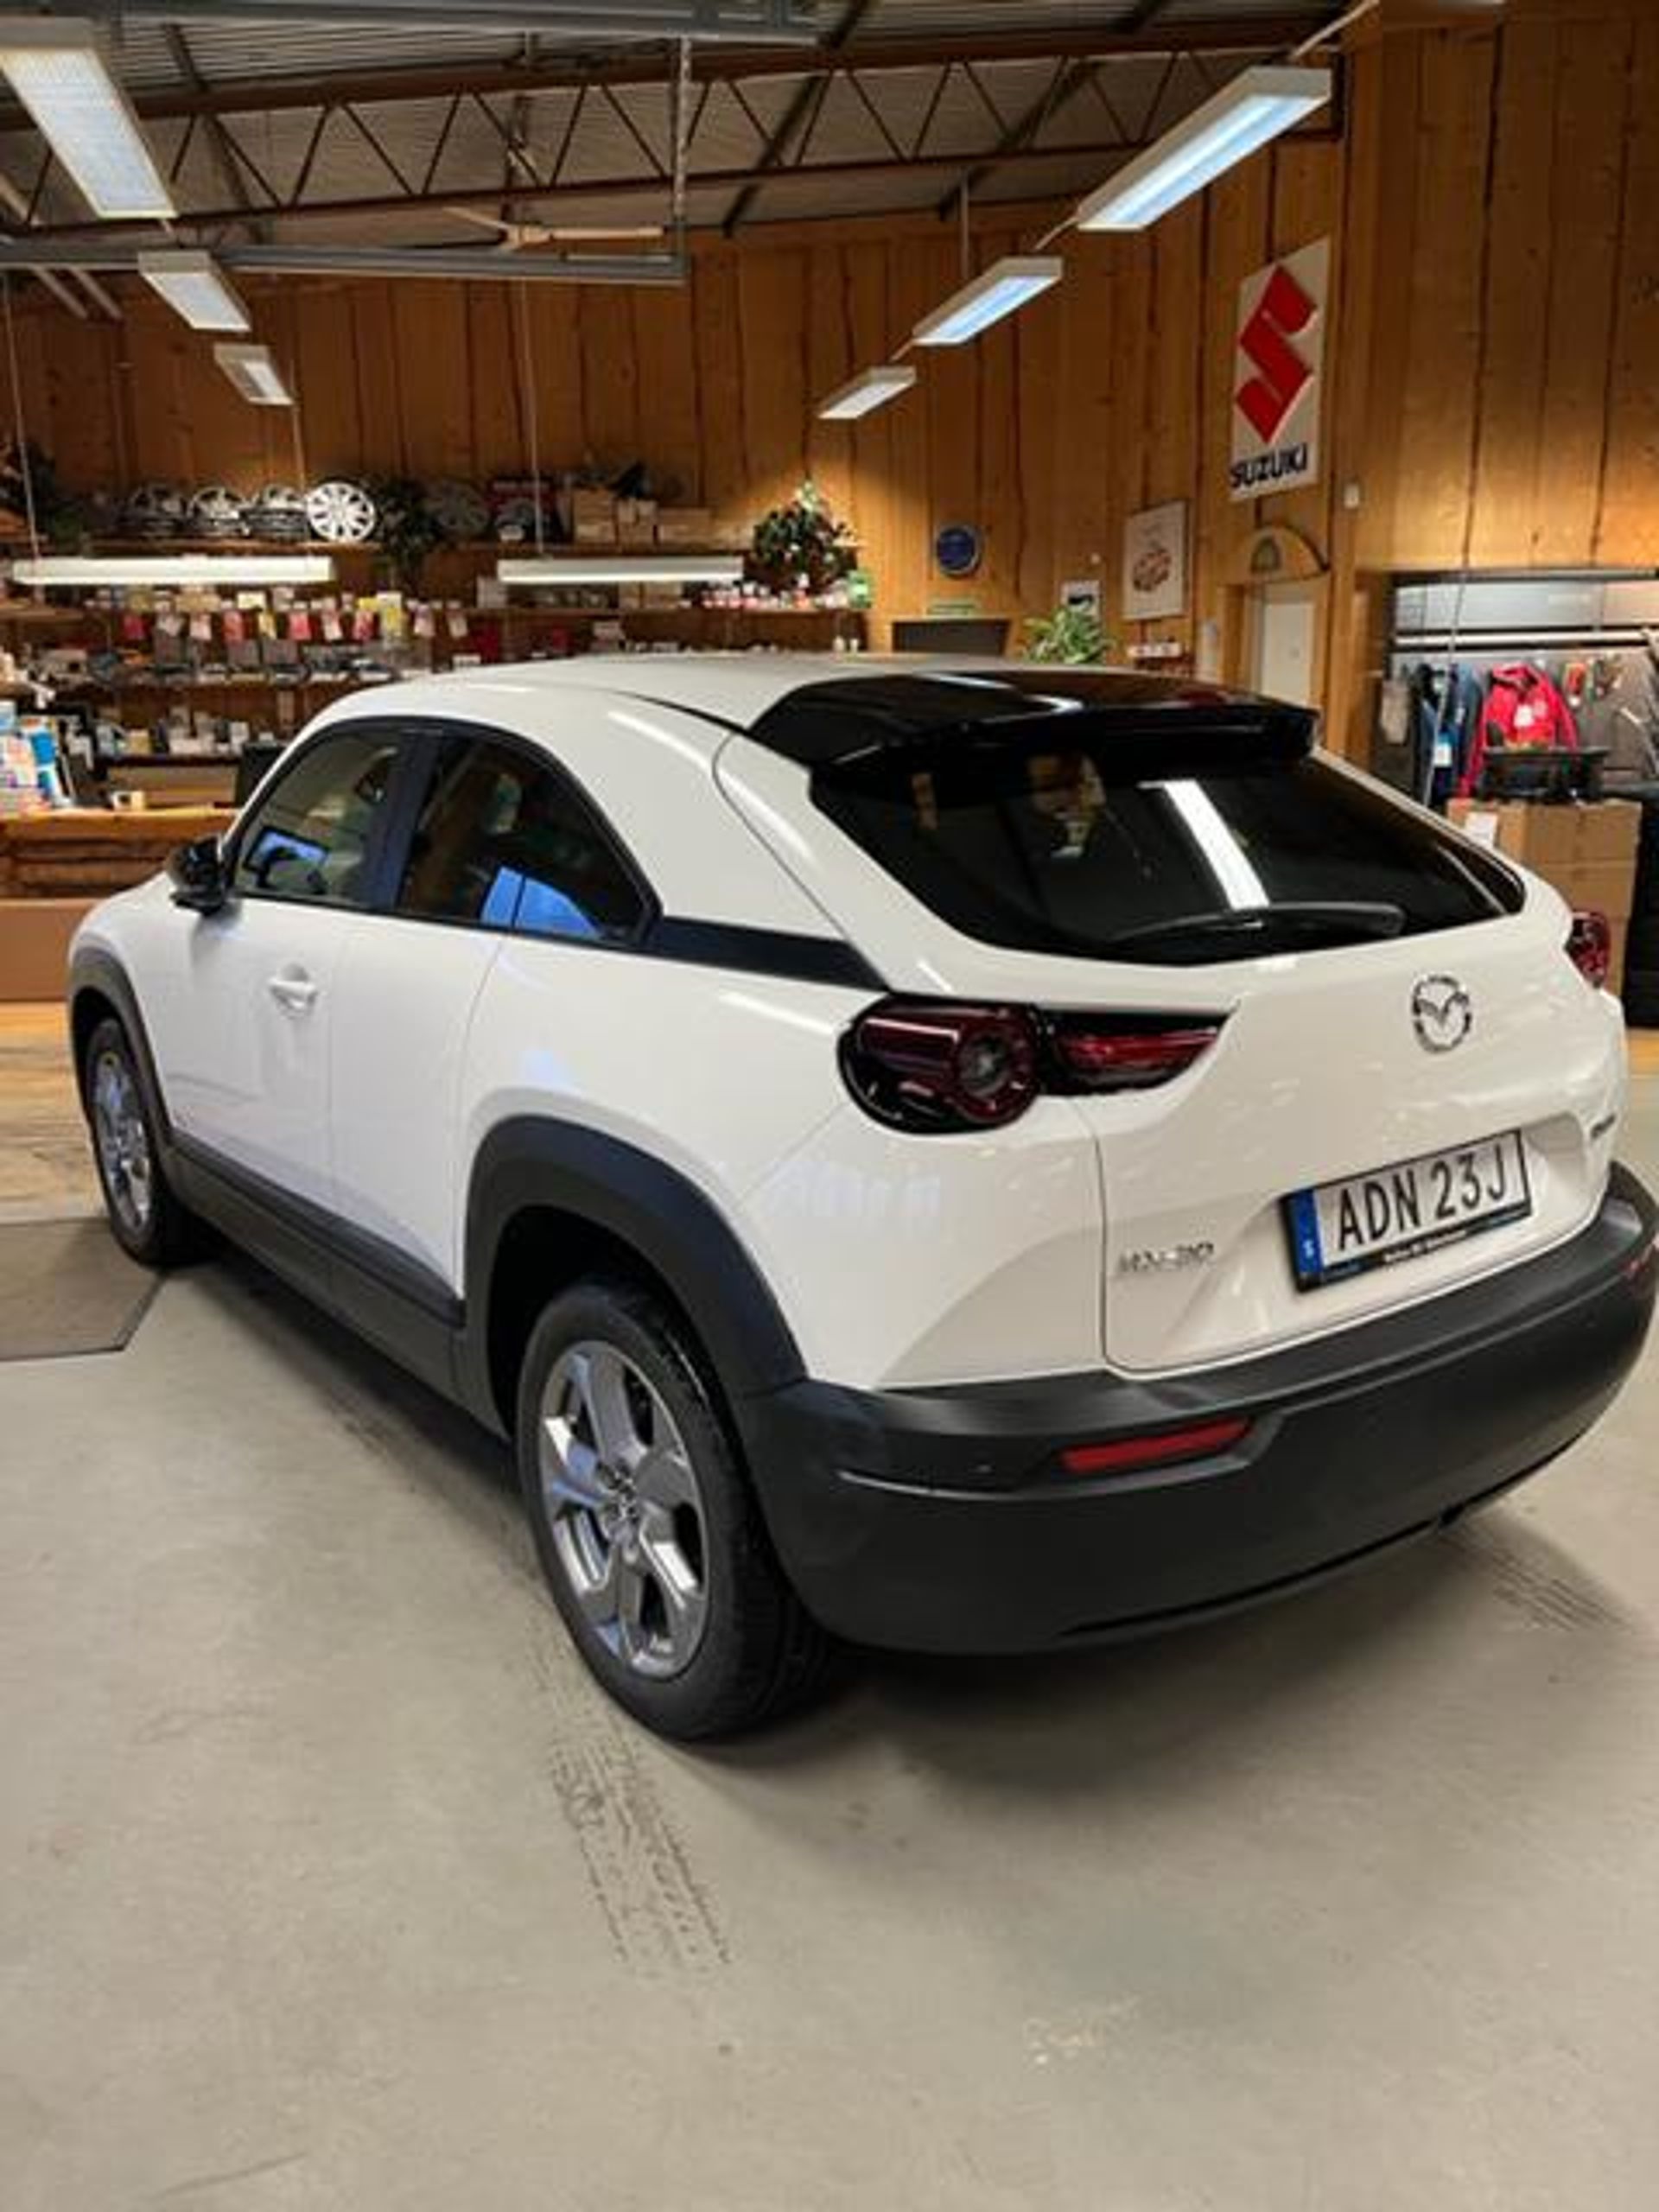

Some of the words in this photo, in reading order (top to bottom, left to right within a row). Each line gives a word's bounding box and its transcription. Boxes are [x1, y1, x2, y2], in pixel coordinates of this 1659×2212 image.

[1230, 442, 1307, 489] SUZUKI
[1339, 1168, 1421, 1251] ADN
[1430, 1142, 1506, 1221] 23J
